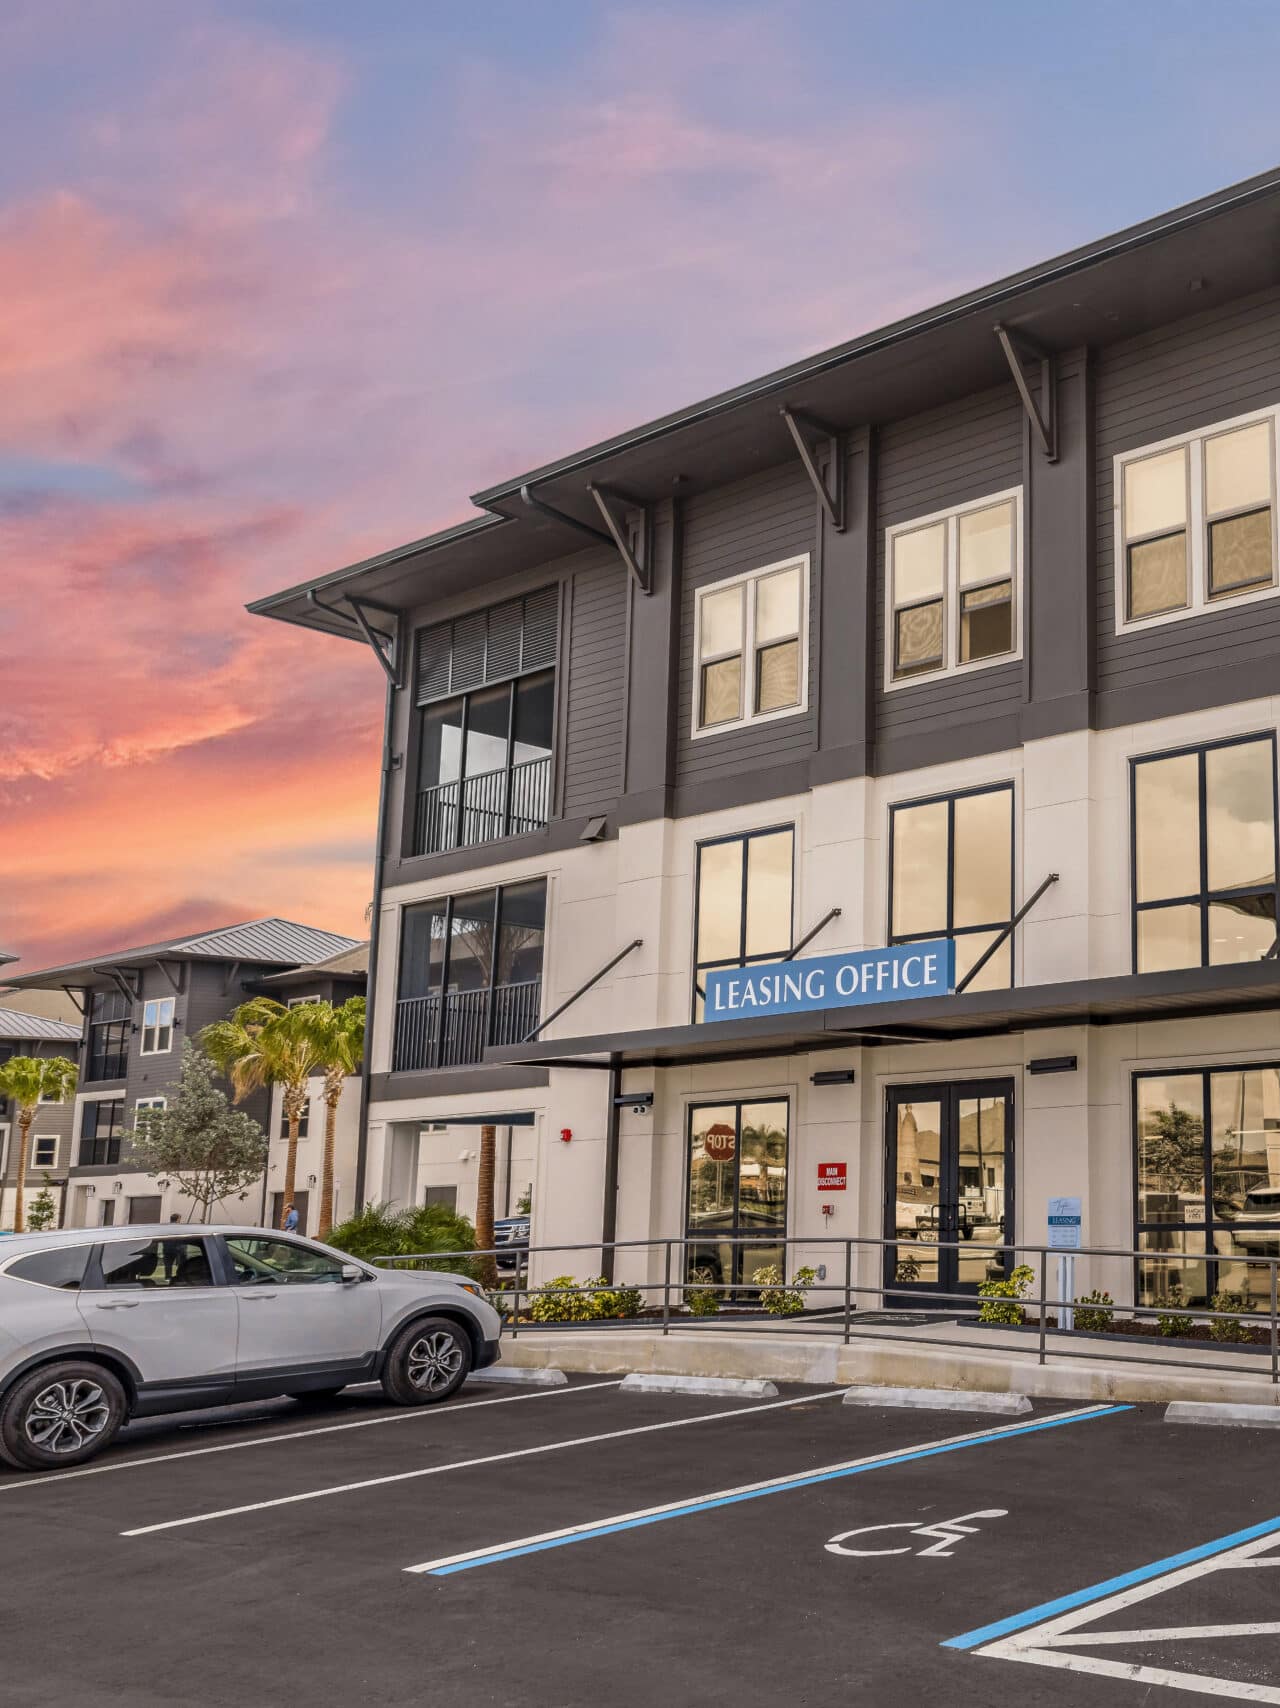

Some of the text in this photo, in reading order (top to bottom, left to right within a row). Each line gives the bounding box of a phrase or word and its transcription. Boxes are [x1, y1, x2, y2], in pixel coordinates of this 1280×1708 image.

[715, 954, 937, 1010] LEASING OFFICE
[826, 1167, 838, 1176] MAIN
